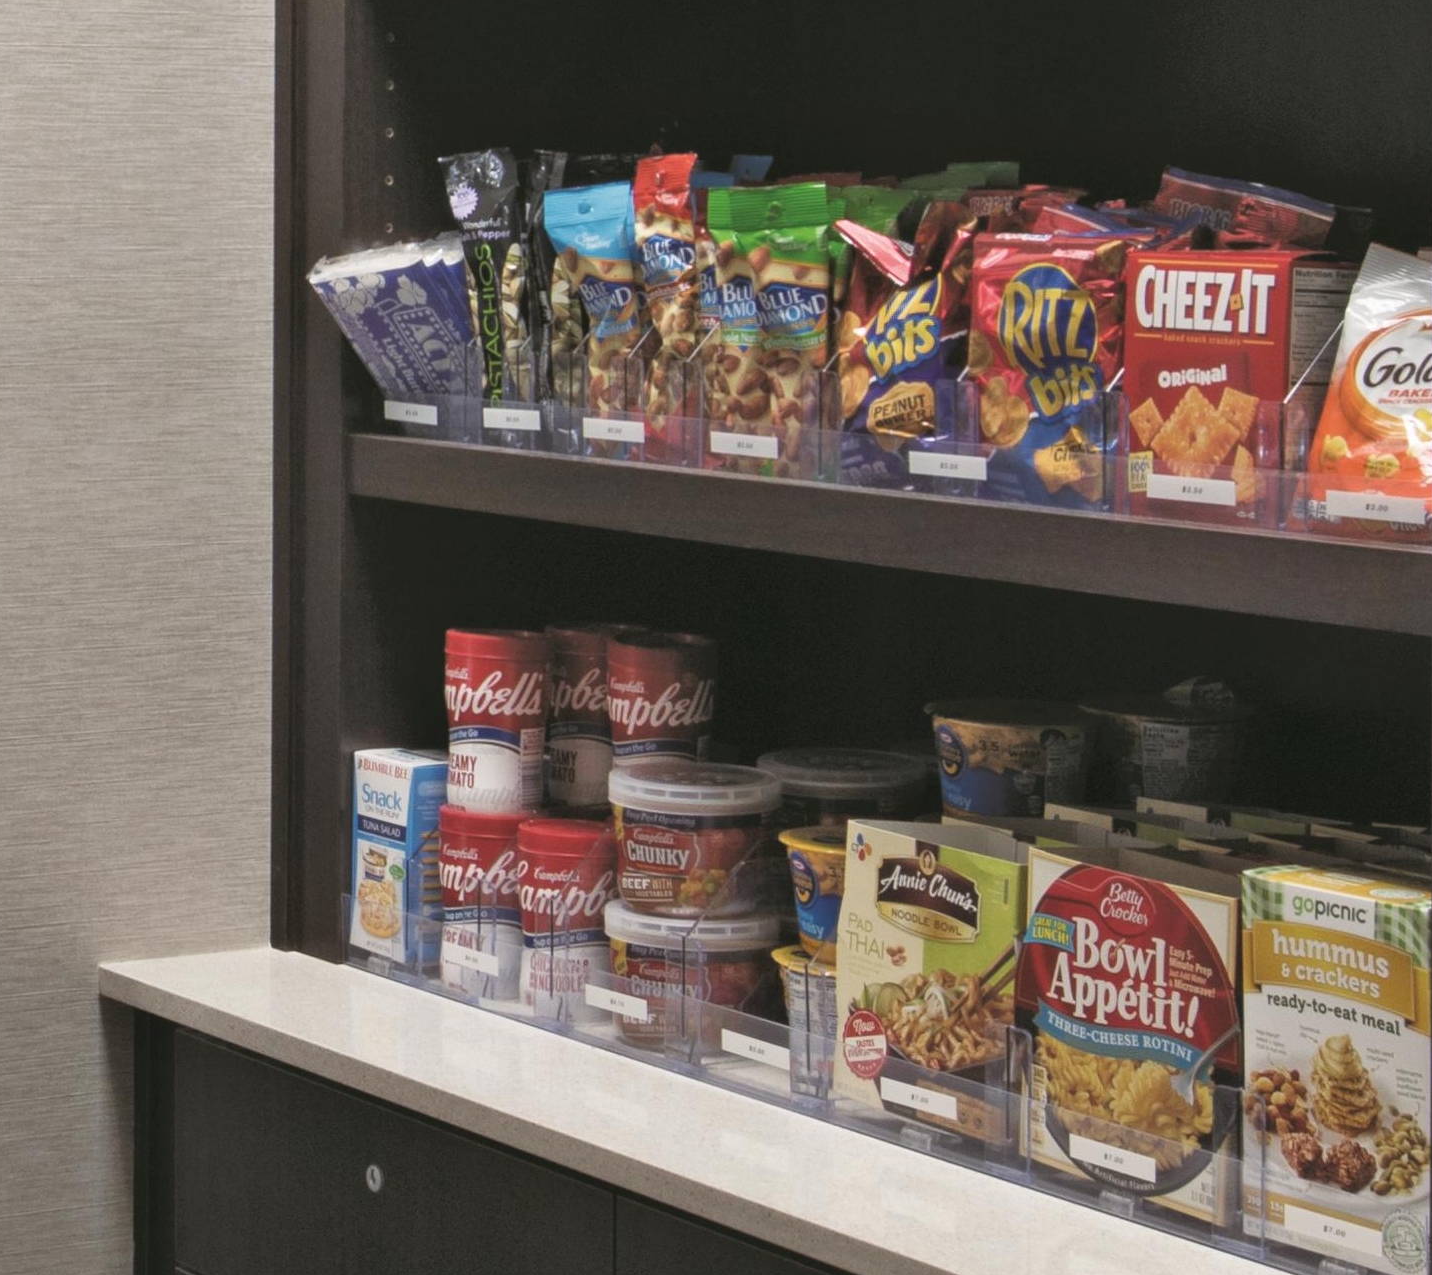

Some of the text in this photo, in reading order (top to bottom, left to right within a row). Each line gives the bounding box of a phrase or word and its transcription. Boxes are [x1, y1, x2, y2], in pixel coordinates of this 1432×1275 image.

[762, 286, 801, 310] BLUE
[1000, 276, 1098, 365] RITZ
[866, 316, 937, 370] bits
[1035, 365, 1098, 416] bits
[873, 393, 926, 421] PEANUT
[362, 782, 403, 812] Snack
[362, 818, 401, 838] TUNA SALAD
[626, 843, 691, 870] CHUNKY
[621, 876, 651, 890] BEEF
[881, 864, 978, 914] Annie Chun's
[1109, 882, 1144, 910] Betty
[847, 913, 873, 935] PAD
[889, 905, 964, 939] NOODLE BOWL
[1099, 896, 1149, 926] Crocker
[1291, 894, 1369, 925] gopicnic
[844, 930, 886, 961] THAI
[1032, 926, 1070, 945] LUNCH!
[1071, 916, 1167, 987] Bowl
[1168, 945, 1184, 960] Easy
[1270, 927, 1391, 980] hummus
[1194, 964, 1213, 979] Prep
[1279, 961, 1383, 999] & crackers
[1046, 950, 1201, 1039] Appétit!
[1266, 992, 1403, 1037] ready-to-eat meal
[1047, 1010, 1194, 1063] THREE-CHEESE ROTINI
